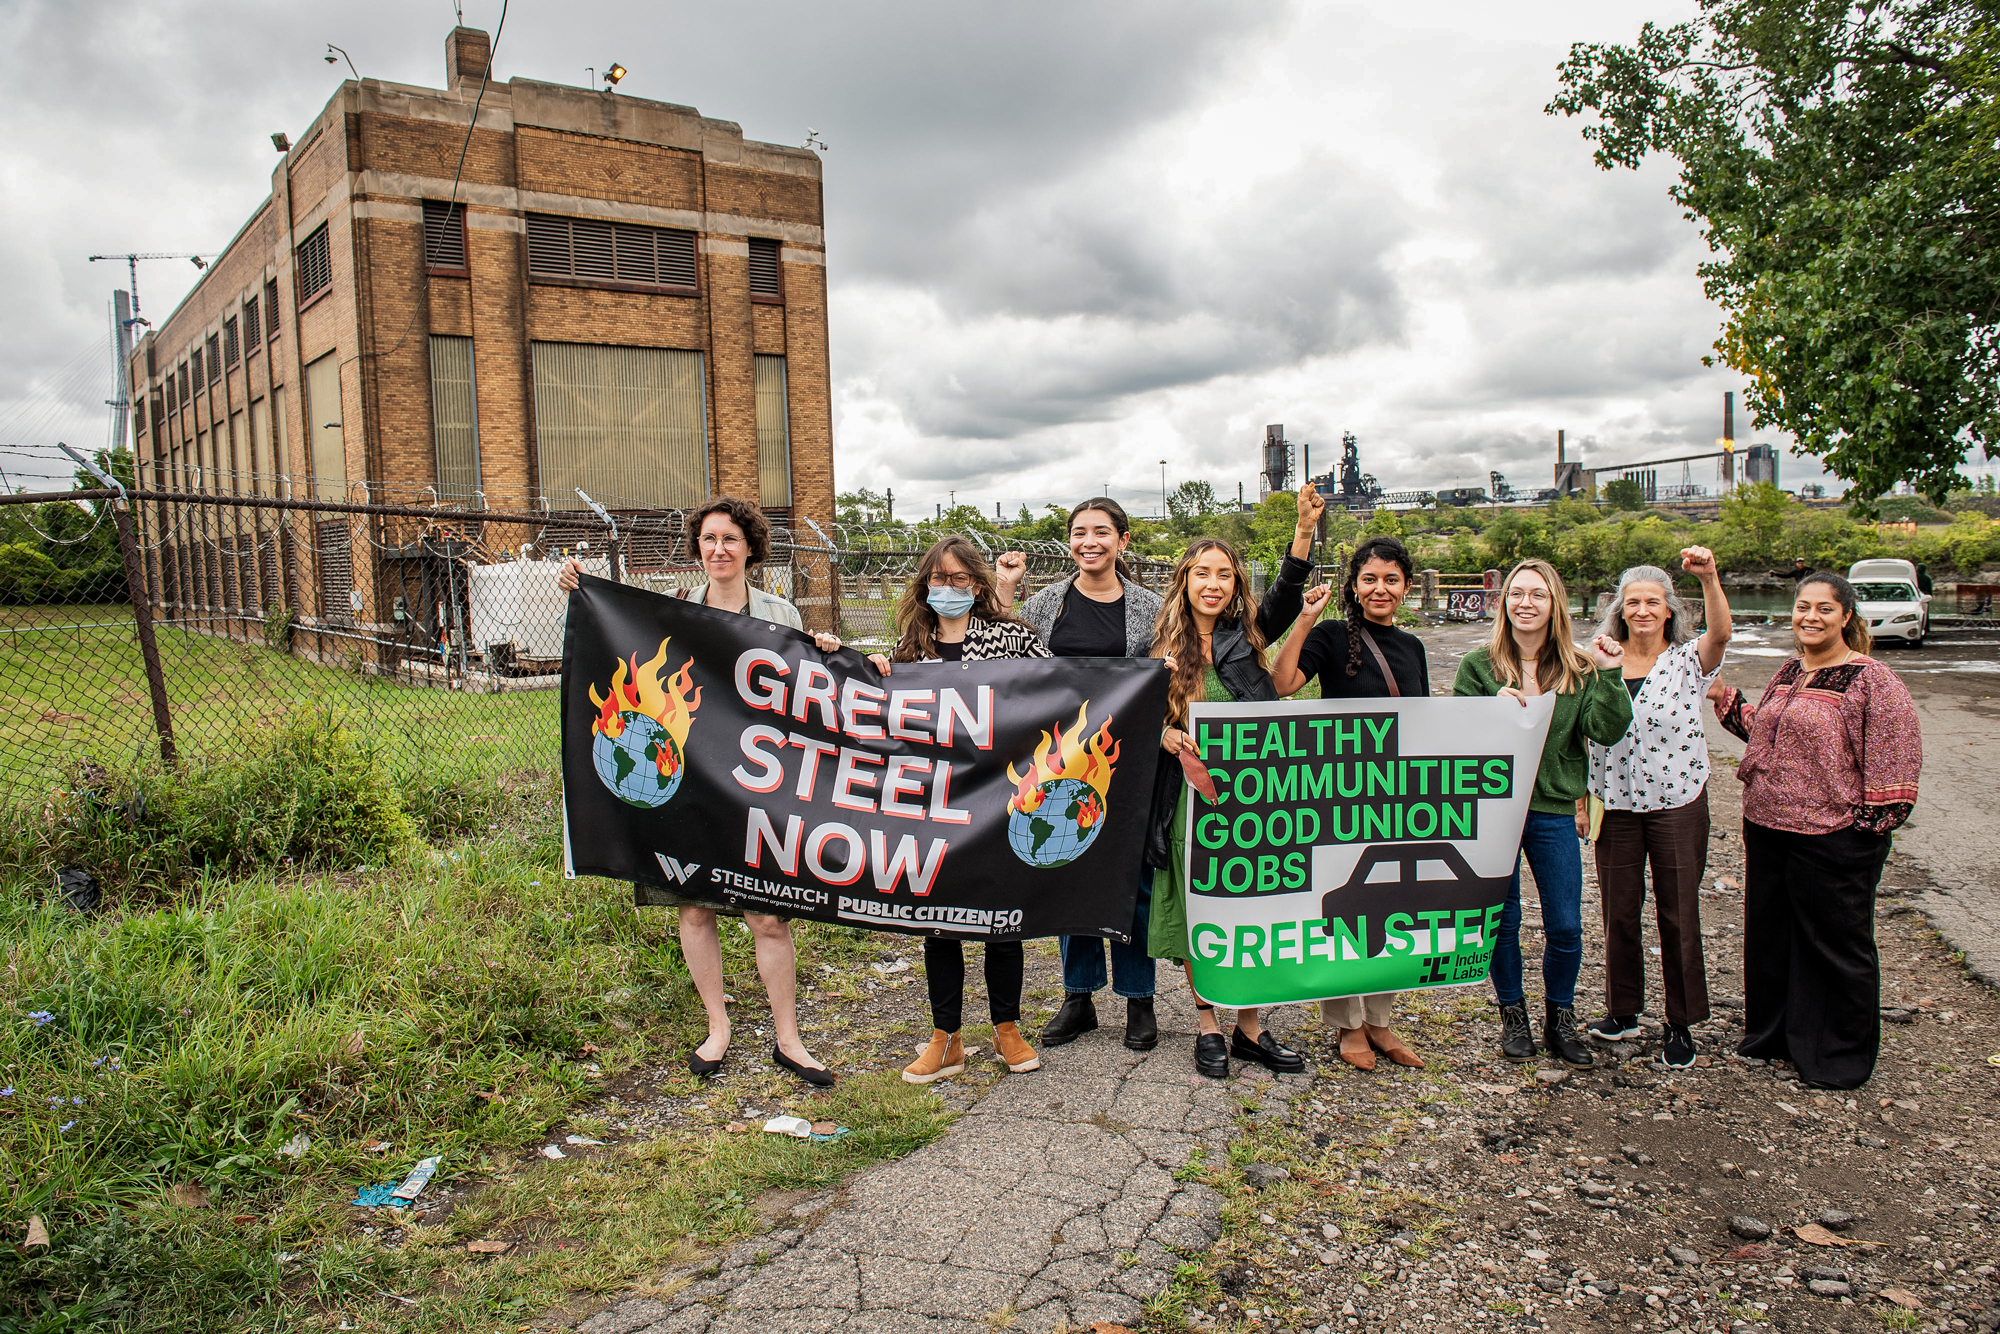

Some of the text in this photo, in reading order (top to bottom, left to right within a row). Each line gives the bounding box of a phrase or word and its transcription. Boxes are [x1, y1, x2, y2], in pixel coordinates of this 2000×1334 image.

[735, 648, 993, 750] GREEN
[1199, 718, 1394, 760] HEALTHY
[732, 724, 971, 825] STEEL
[1199, 759, 1509, 806] COMMUNITIES
[1196, 802, 1471, 850] GOOD UNION
[744, 806, 949, 897] NOW
[1192, 852, 1306, 893] JOBS
[710, 867, 829, 905] STEELWATCH
[723, 887, 748, 900] Bringing
[748, 894, 769, 903] climate
[769, 899, 793, 908] urgency
[837, 895, 913, 919] PUBLIC
[992, 925, 1022, 935] YEARS
[1191, 915, 1368, 967] GREEN
[1453, 966, 1484, 980] Labs
